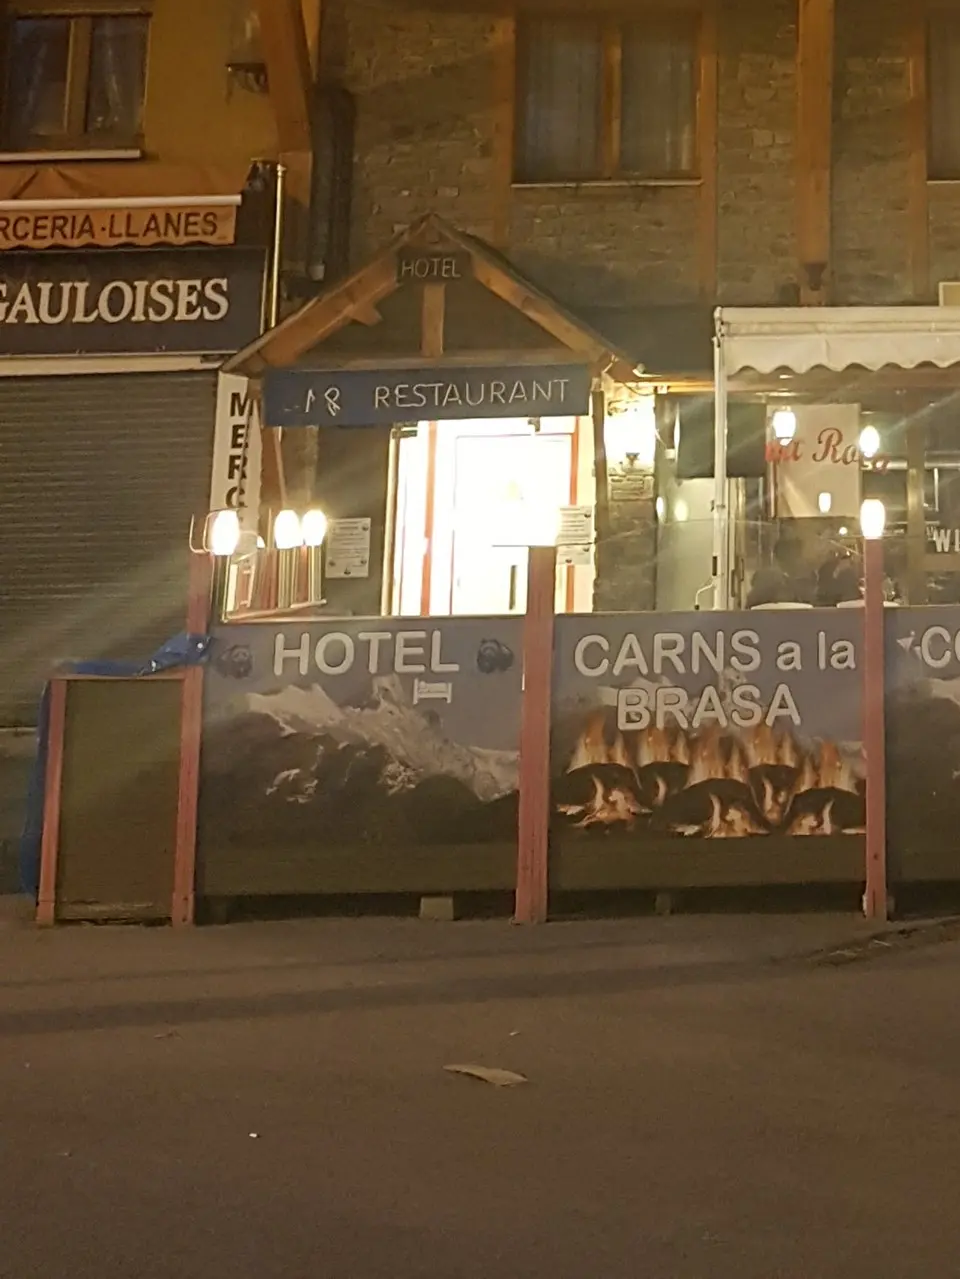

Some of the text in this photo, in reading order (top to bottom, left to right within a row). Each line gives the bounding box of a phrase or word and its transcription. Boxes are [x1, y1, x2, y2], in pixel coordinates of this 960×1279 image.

[107, 212, 218, 238] LLANES
[401, 257, 461, 279] HOTEL
[375, 379, 570, 409] RESTAURANT
[272, 629, 460, 677] HOTEL
[573, 628, 857, 678] CARNS a la
[616, 682, 802, 732] BRASA
